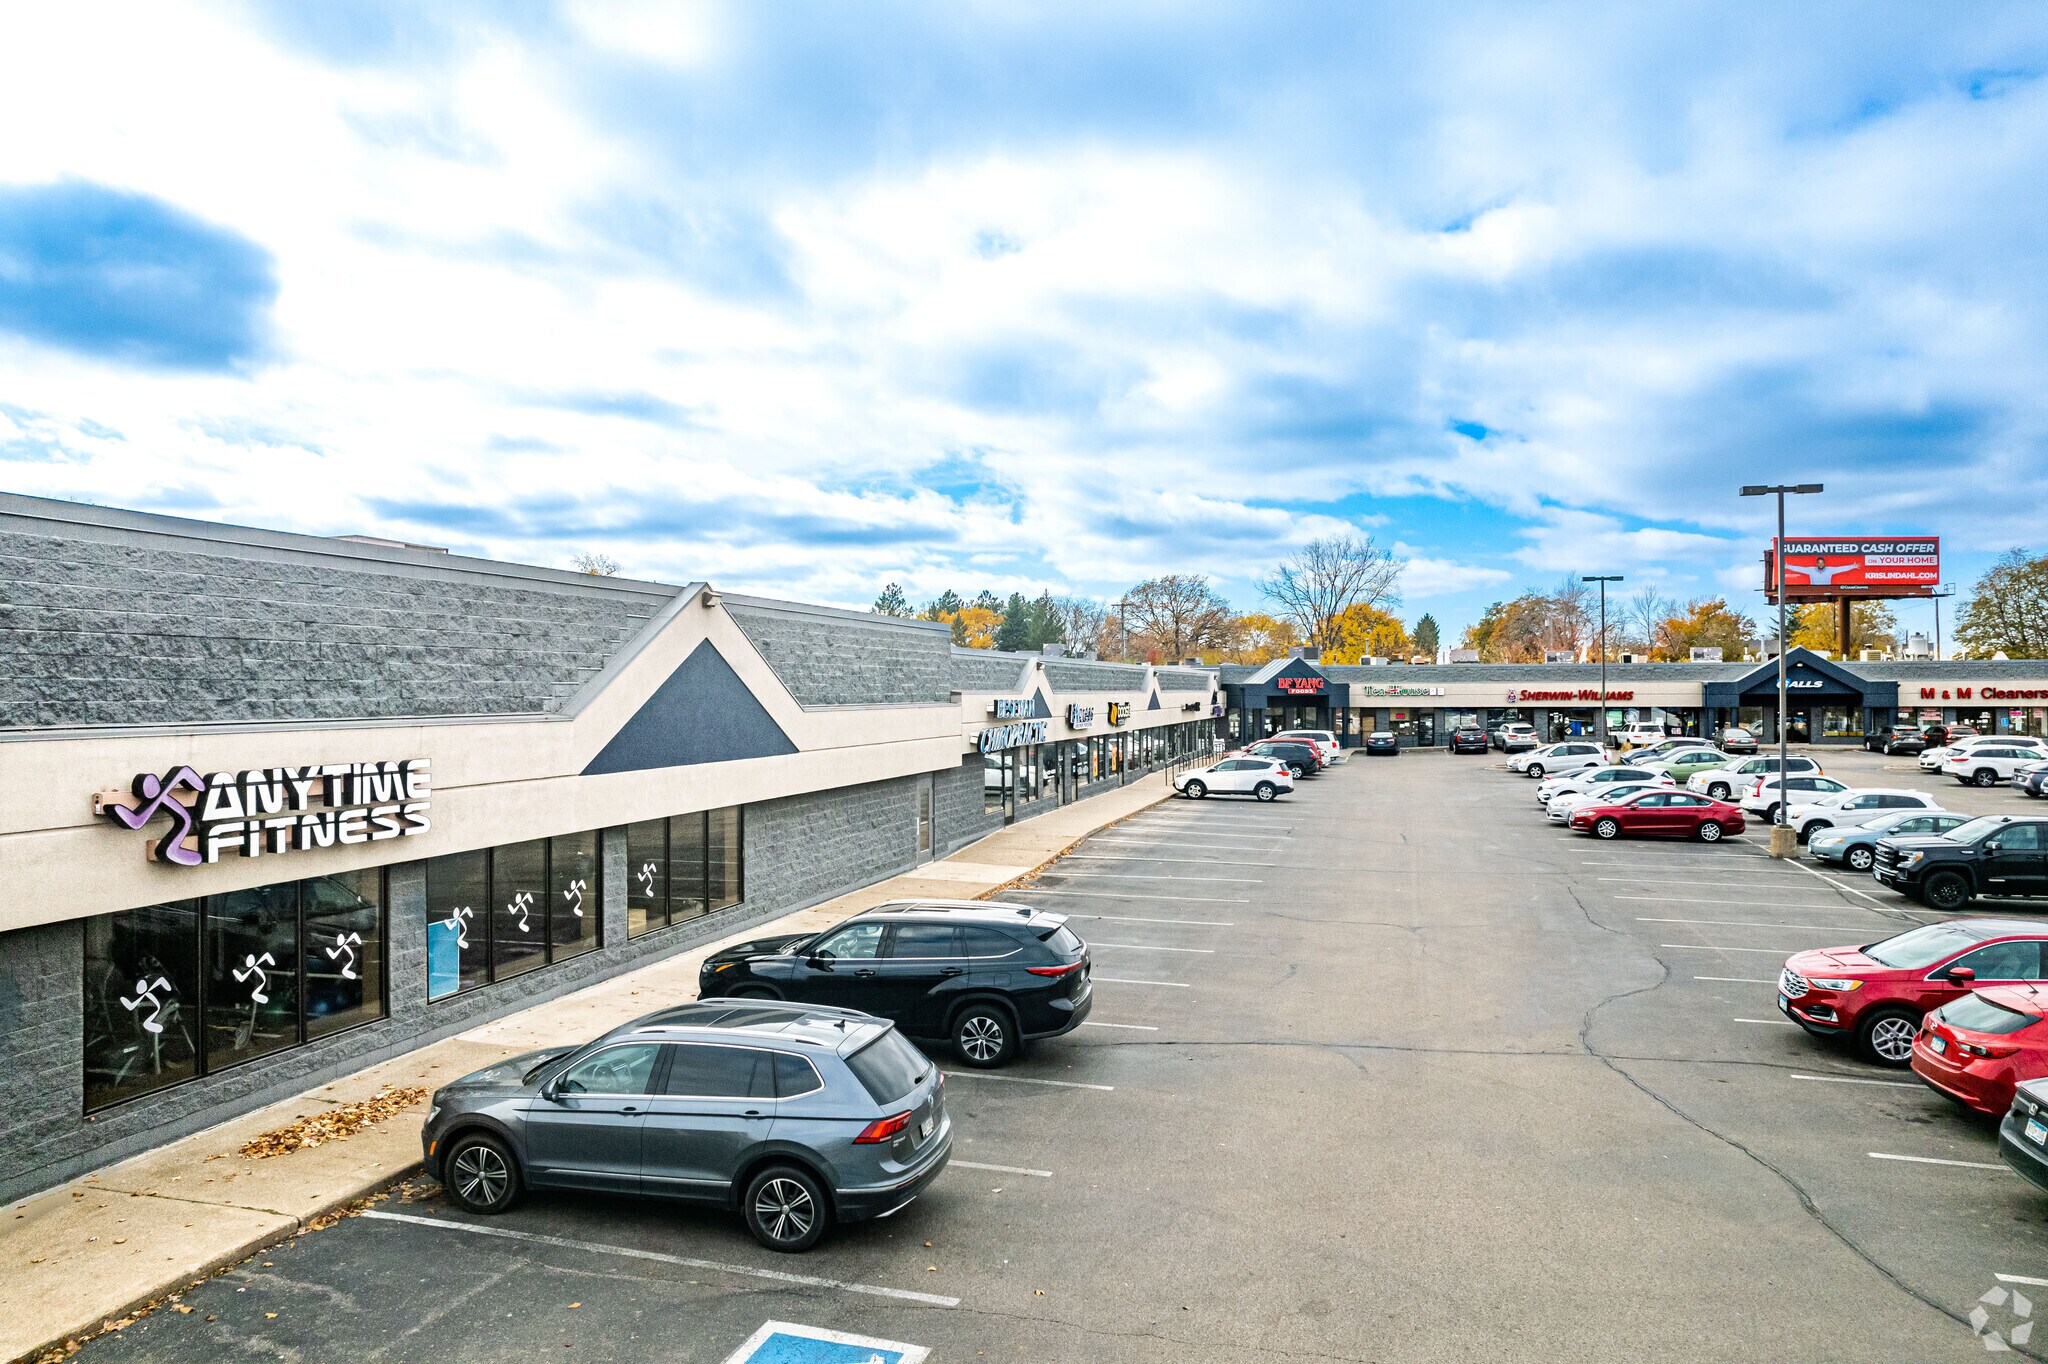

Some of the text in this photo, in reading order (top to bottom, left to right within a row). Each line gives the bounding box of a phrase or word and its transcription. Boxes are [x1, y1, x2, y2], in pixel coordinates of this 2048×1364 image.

[1861, 543, 1894, 553] CASH
[1896, 543, 1935, 553] OFFER
[1880, 556, 1905, 564] YOUR
[1907, 556, 1935, 564] HOME
[1293, 677, 1324, 689] YANG
[1364, 685, 1386, 697] Tea
[1519, 689, 1634, 701] SHERWIN-WILLIAMS
[1920, 686, 2048, 700] M & M Cleaners
[201, 757, 432, 821] ANYTIME
[207, 801, 432, 864] FITNESS
